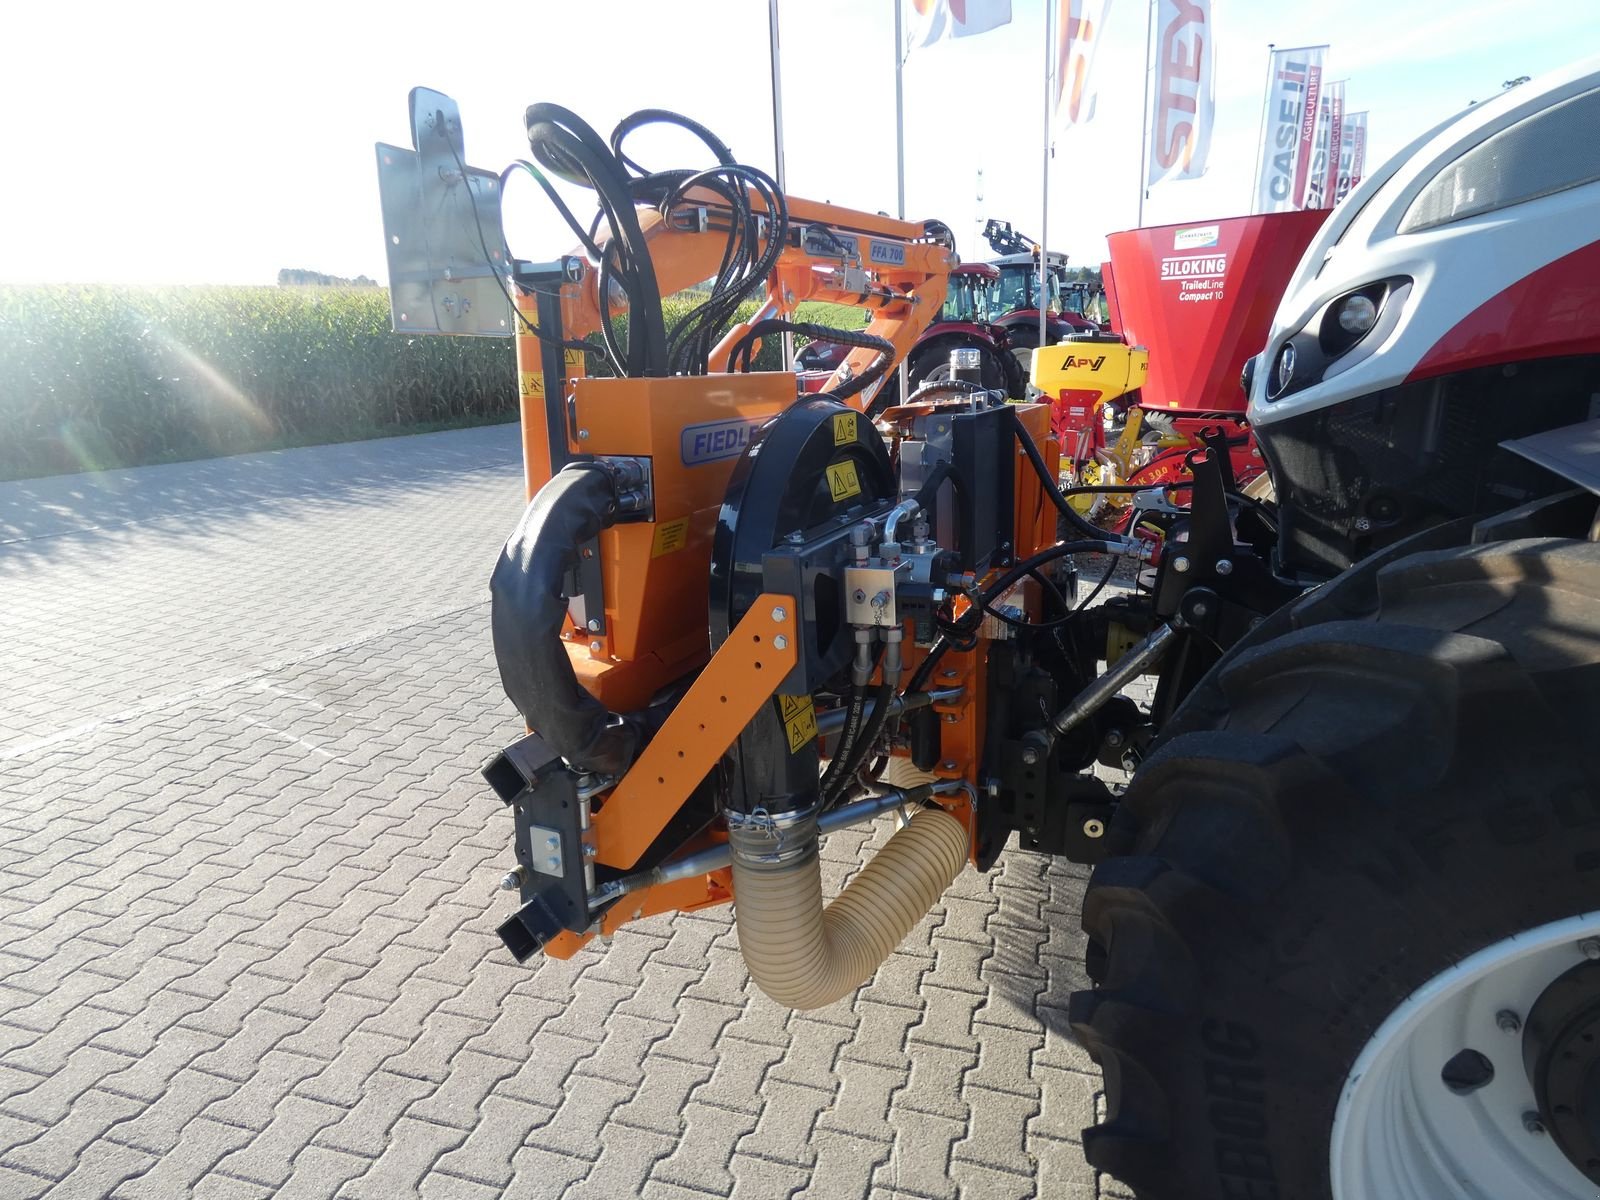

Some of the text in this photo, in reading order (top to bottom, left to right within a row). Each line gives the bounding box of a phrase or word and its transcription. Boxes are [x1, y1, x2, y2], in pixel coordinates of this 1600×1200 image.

[1302, 70, 1319, 142] AGRICULTURE
[1270, 99, 1302, 202] CASE
[871, 245, 887, 258] FFA
[889, 247, 903, 261] 700
[1161, 259, 1226, 276] SILOKING
[1181, 279, 1224, 290] TrailedLine
[1179, 291, 1224, 303] Compact 10
[1148, 466, 1168, 480] 300
